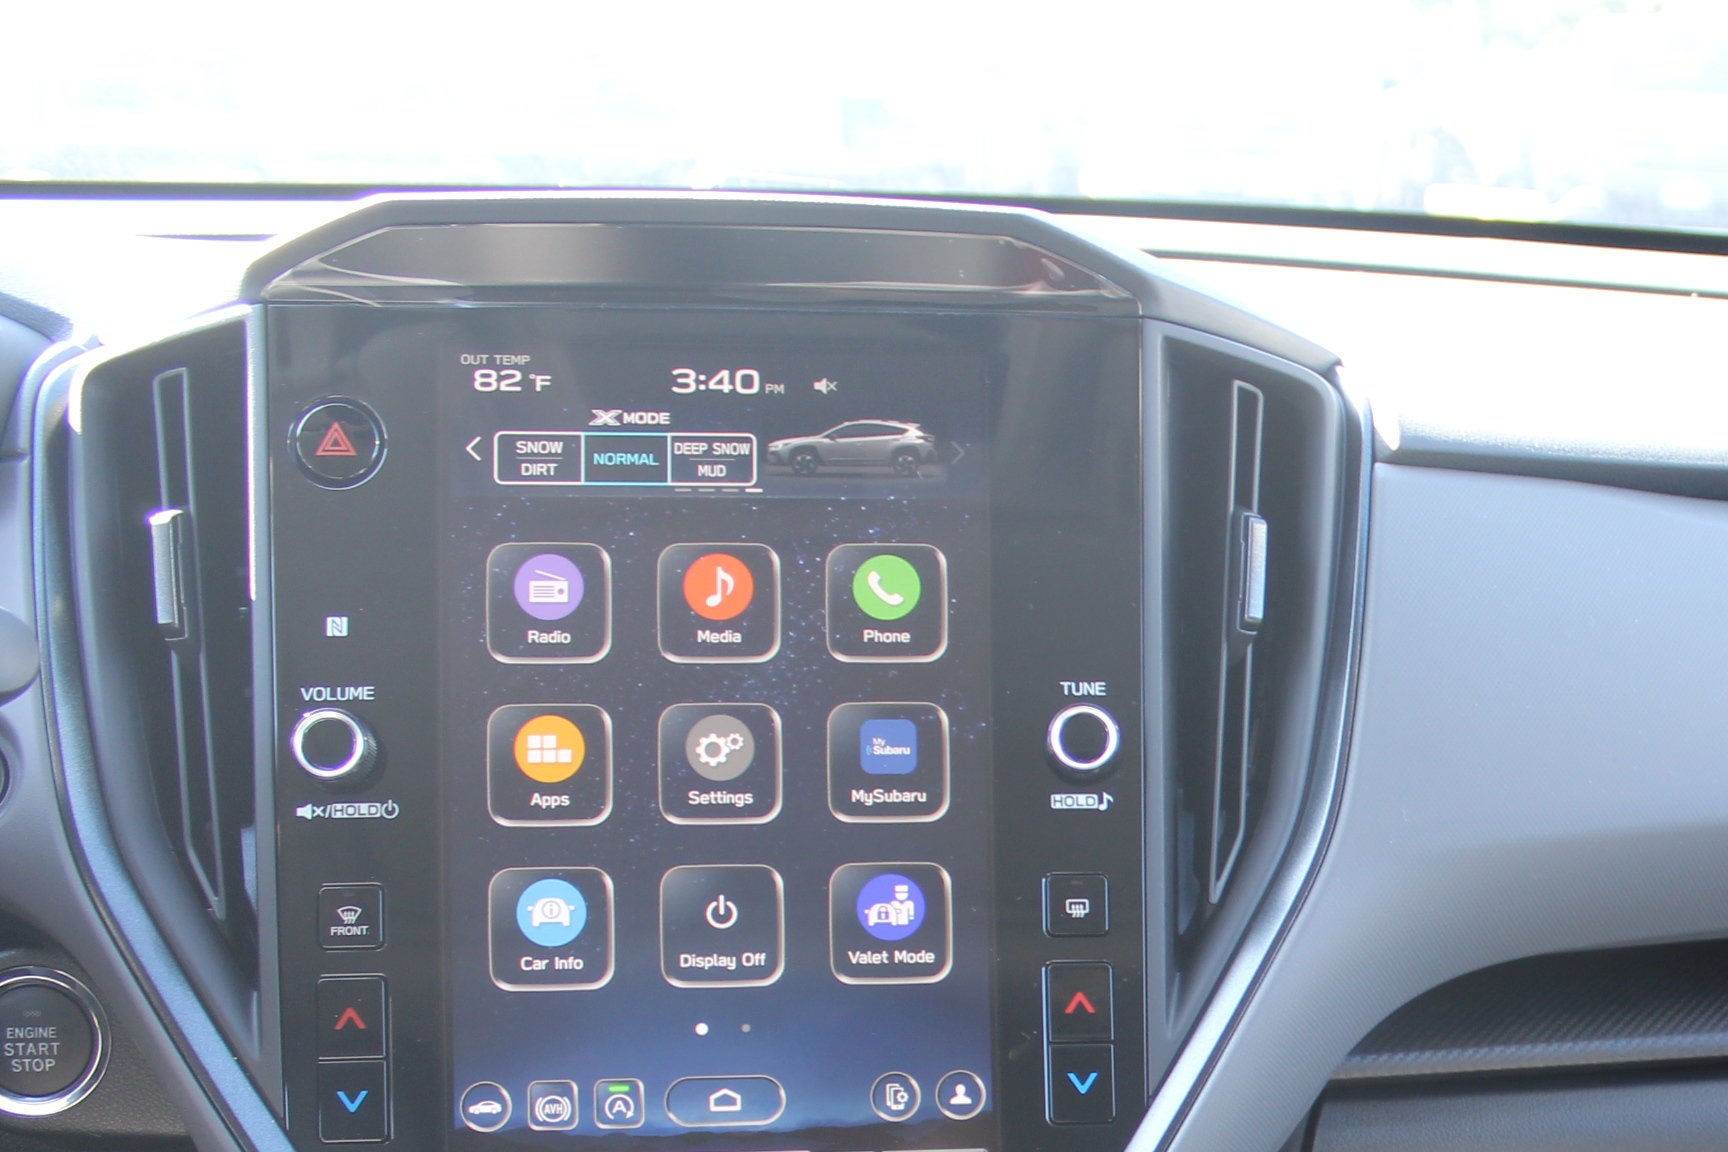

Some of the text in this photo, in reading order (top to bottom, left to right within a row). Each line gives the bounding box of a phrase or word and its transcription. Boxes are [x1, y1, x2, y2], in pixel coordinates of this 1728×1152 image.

[461, 354, 531, 365] OUT TEMP
[473, 370, 522, 392] 82
[671, 368, 785, 394] 3:40 PM
[515, 441, 563, 454] SNOW
[674, 442, 750, 456] DEEP SNOW
[593, 452, 659, 466] NORMAL
[521, 463, 558, 476] DIRT
[698, 465, 726, 477] MUD
[527, 630, 571, 643] Radio
[697, 630, 742, 643] Media
[863, 629, 911, 643] Phone
[301, 686, 375, 701] VOLUME
[1060, 682, 1106, 697] TUNE
[873, 745, 911, 755] Subaru
[531, 793, 570, 809] Apps
[688, 790, 753, 808] Settings
[851, 789, 927, 805] MySubaru
[1051, 795, 1098, 809] HOLD
[331, 926, 368, 936] FRONT
[521, 956, 583, 971] Car Info
[680, 952, 766, 970] Display Off
[848, 949, 935, 964] Valet Mode
[6, 1027, 57, 1039] ENGINE
[4, 1042, 60, 1056] START
[12, 1058, 56, 1072] STOP
[543, 1103, 564, 1116] AVH
